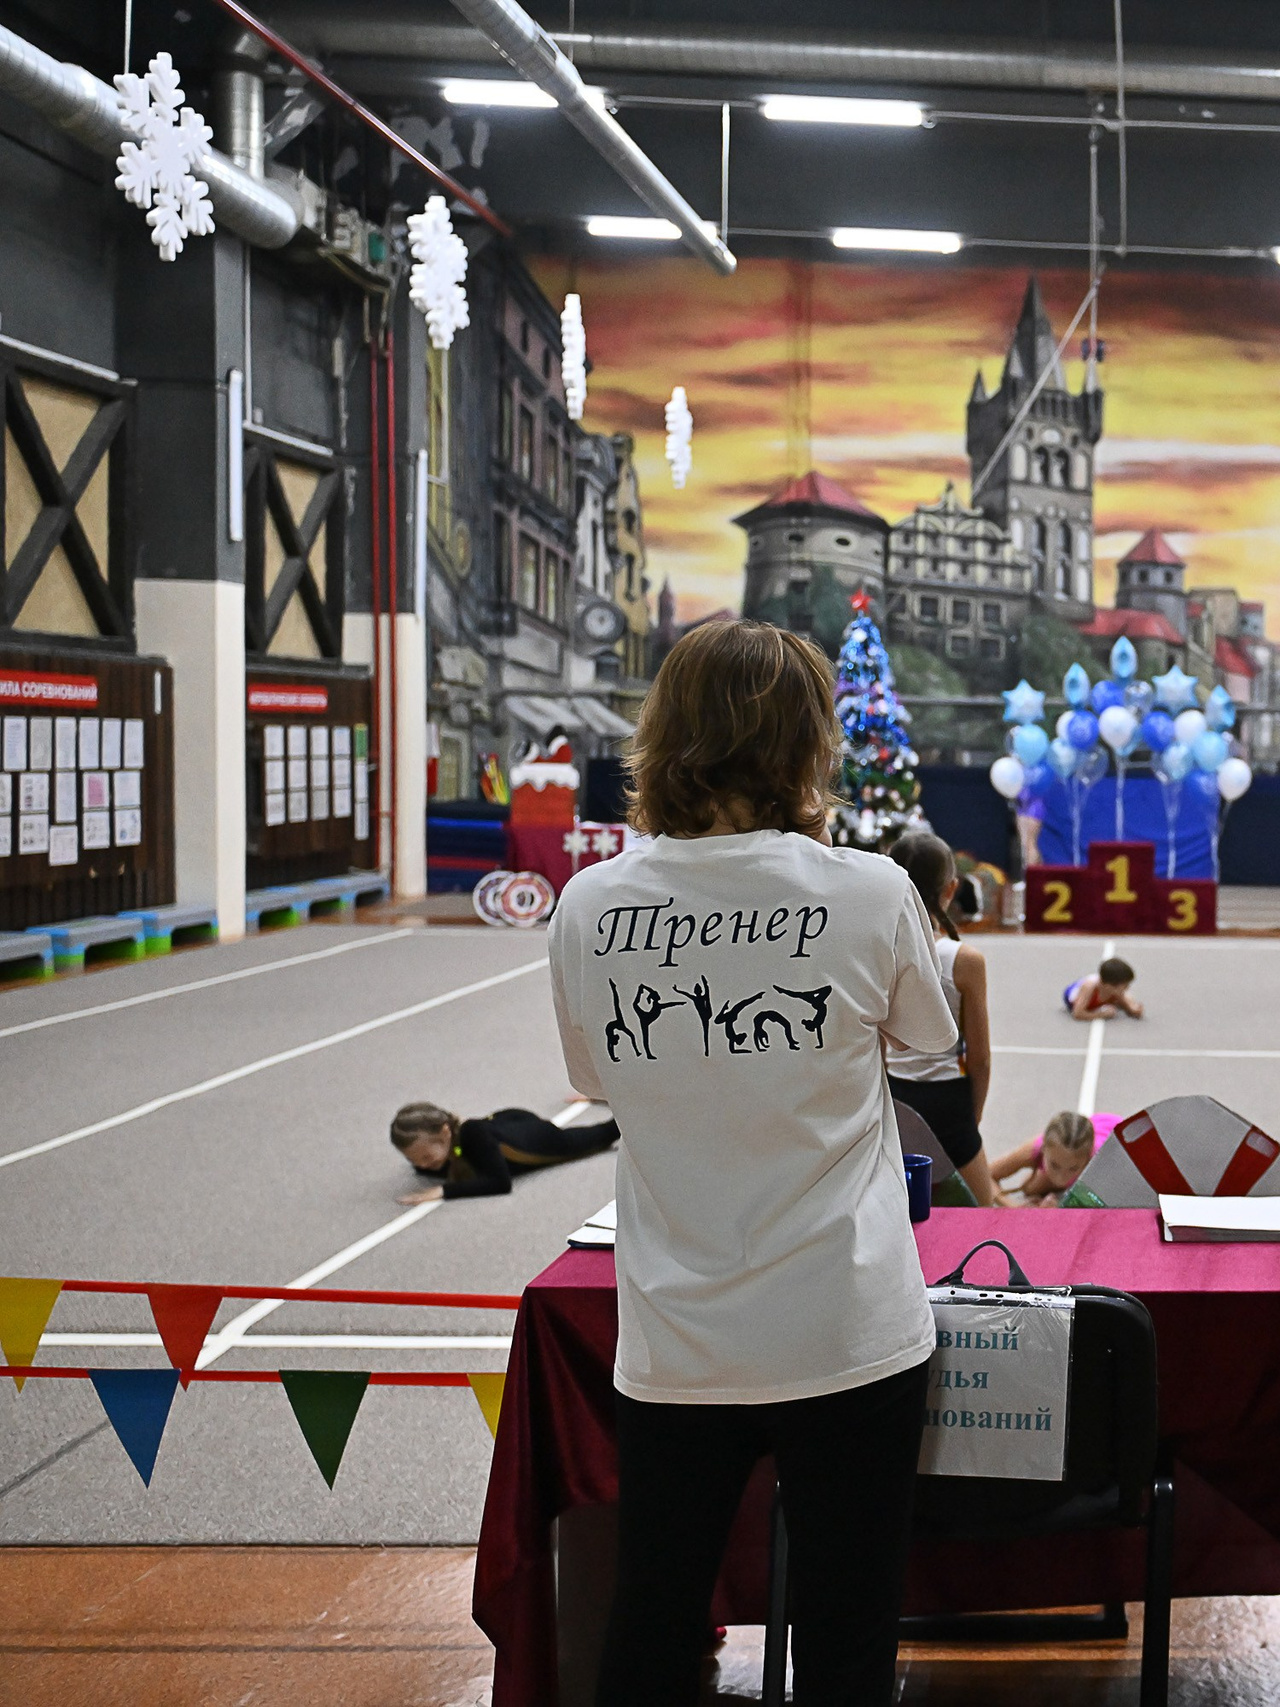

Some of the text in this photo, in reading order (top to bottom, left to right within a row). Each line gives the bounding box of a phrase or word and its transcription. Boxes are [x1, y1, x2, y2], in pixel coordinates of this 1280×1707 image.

[1105, 855, 1137, 903] 1
[1042, 880, 1073, 923] 2
[1167, 889, 1198, 930] 3
[594, 896, 829, 968] Тренер
[936, 1326, 1019, 1350] вный
[928, 1369, 989, 1391] дья
[923, 1407, 1052, 1431] нований
